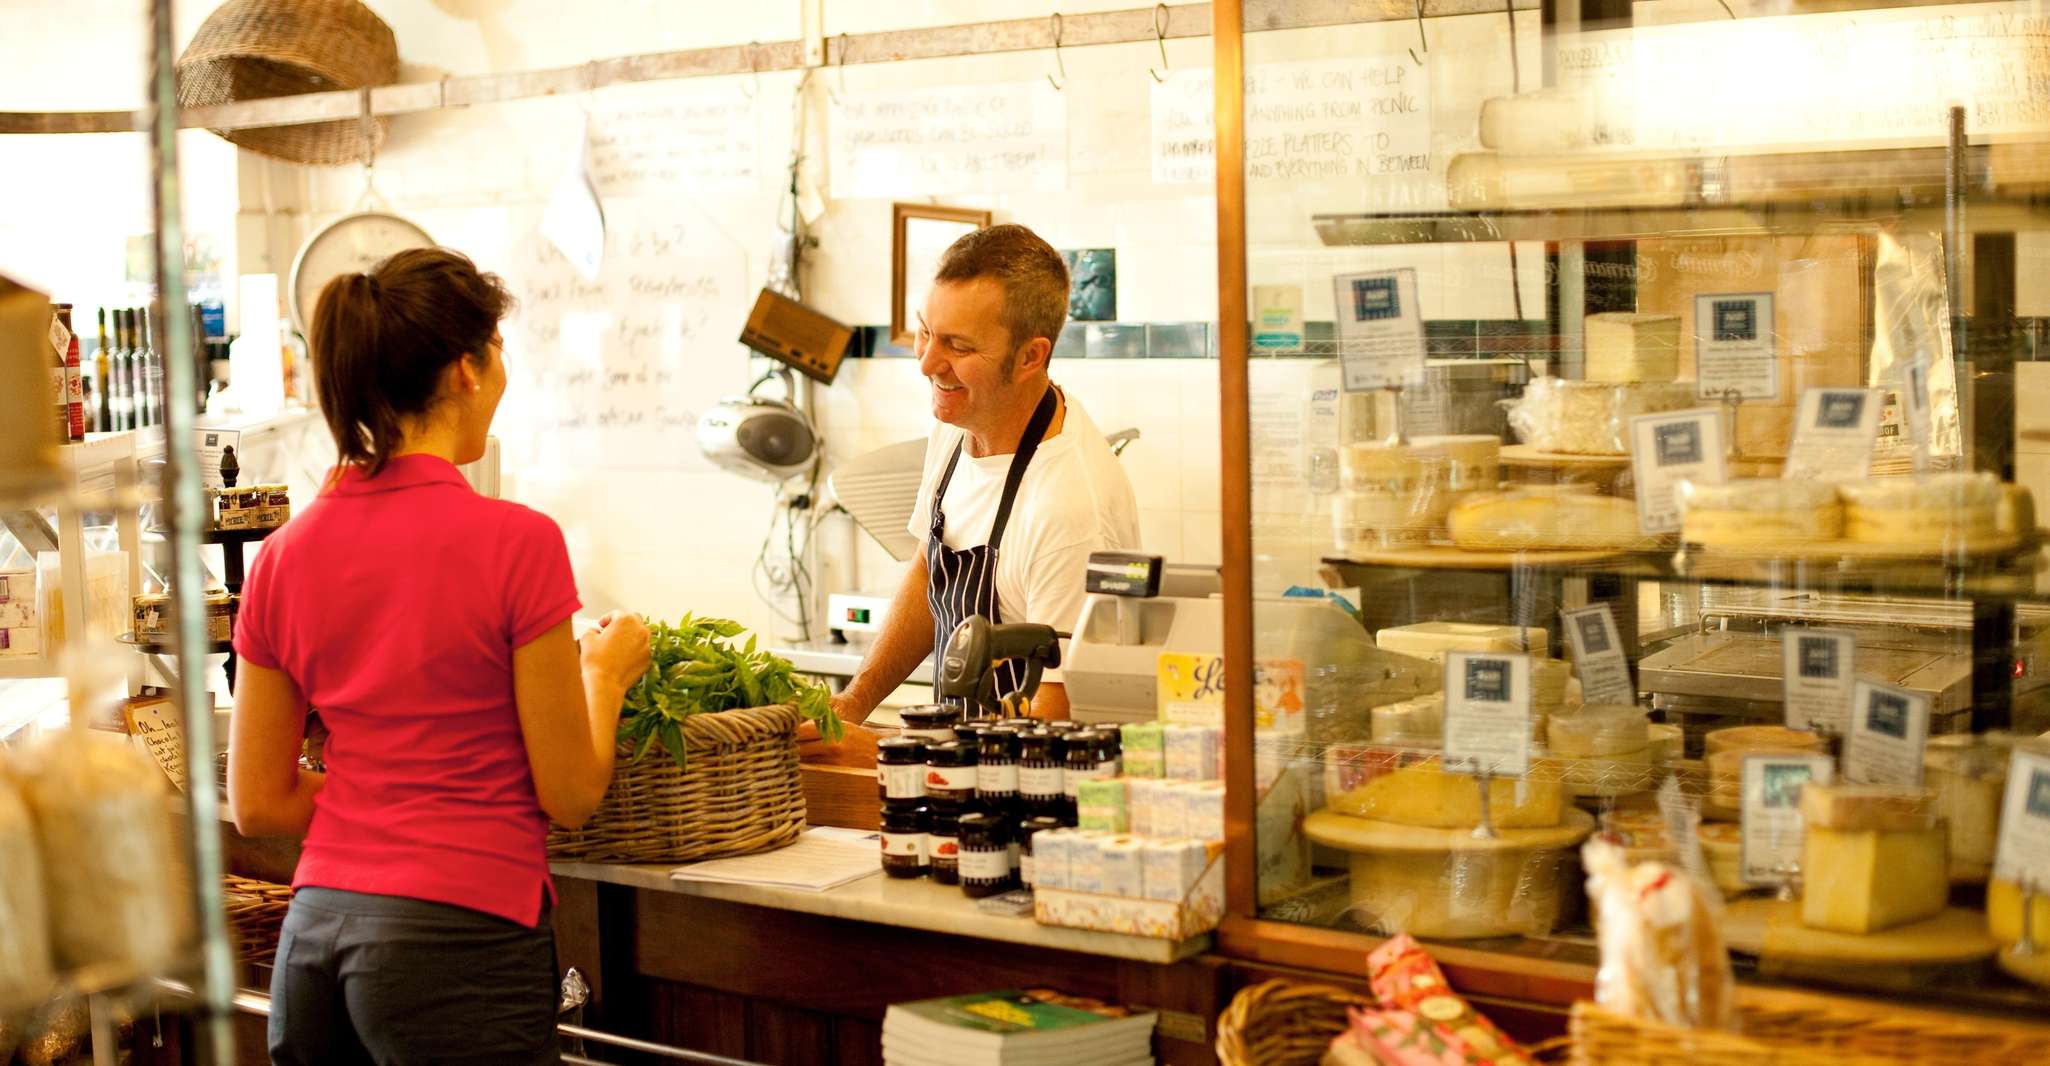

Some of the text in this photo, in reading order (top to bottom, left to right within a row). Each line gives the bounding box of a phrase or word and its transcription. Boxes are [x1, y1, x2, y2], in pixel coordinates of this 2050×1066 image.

[1321, 69, 1353, 91] CAN
[1360, 65, 1407, 87] HELP
[1321, 100, 1361, 119] FROM
[1369, 90, 1421, 114] PICNIC
[1283, 130, 1354, 156] PLATTERS
[1368, 130, 1391, 152] TO
[1248, 152, 1433, 180] AND EVERYTHING IN BETWEEN
